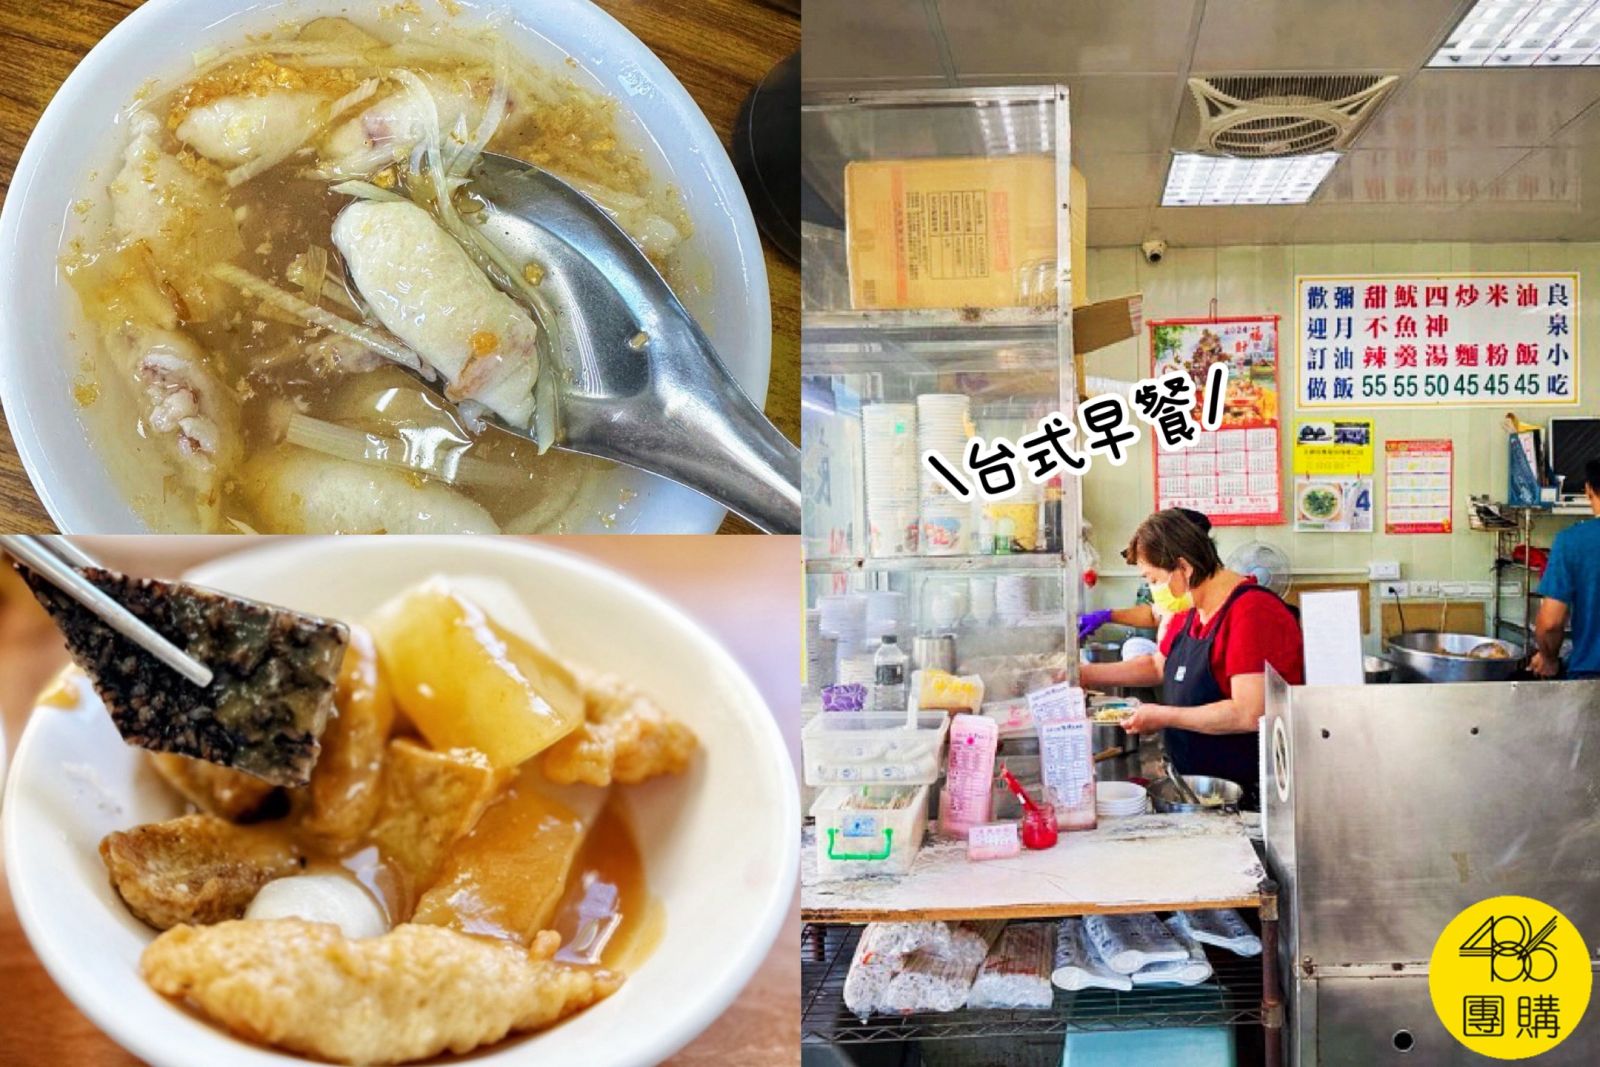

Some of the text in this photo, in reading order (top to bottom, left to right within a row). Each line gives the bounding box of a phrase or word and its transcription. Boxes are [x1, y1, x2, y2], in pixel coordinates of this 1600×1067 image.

[1362, 285, 1388, 397] 甜不辣 55
[1424, 285, 1449, 396] 四神湯 50
[1547, 283, 1569, 396] 良泉小吃
[1394, 375, 1418, 397] 55
[1454, 373, 1479, 396] 45
[1483, 373, 1509, 396] 45
[1514, 373, 1540, 396] 45
[1356, 489, 1371, 512] 4
